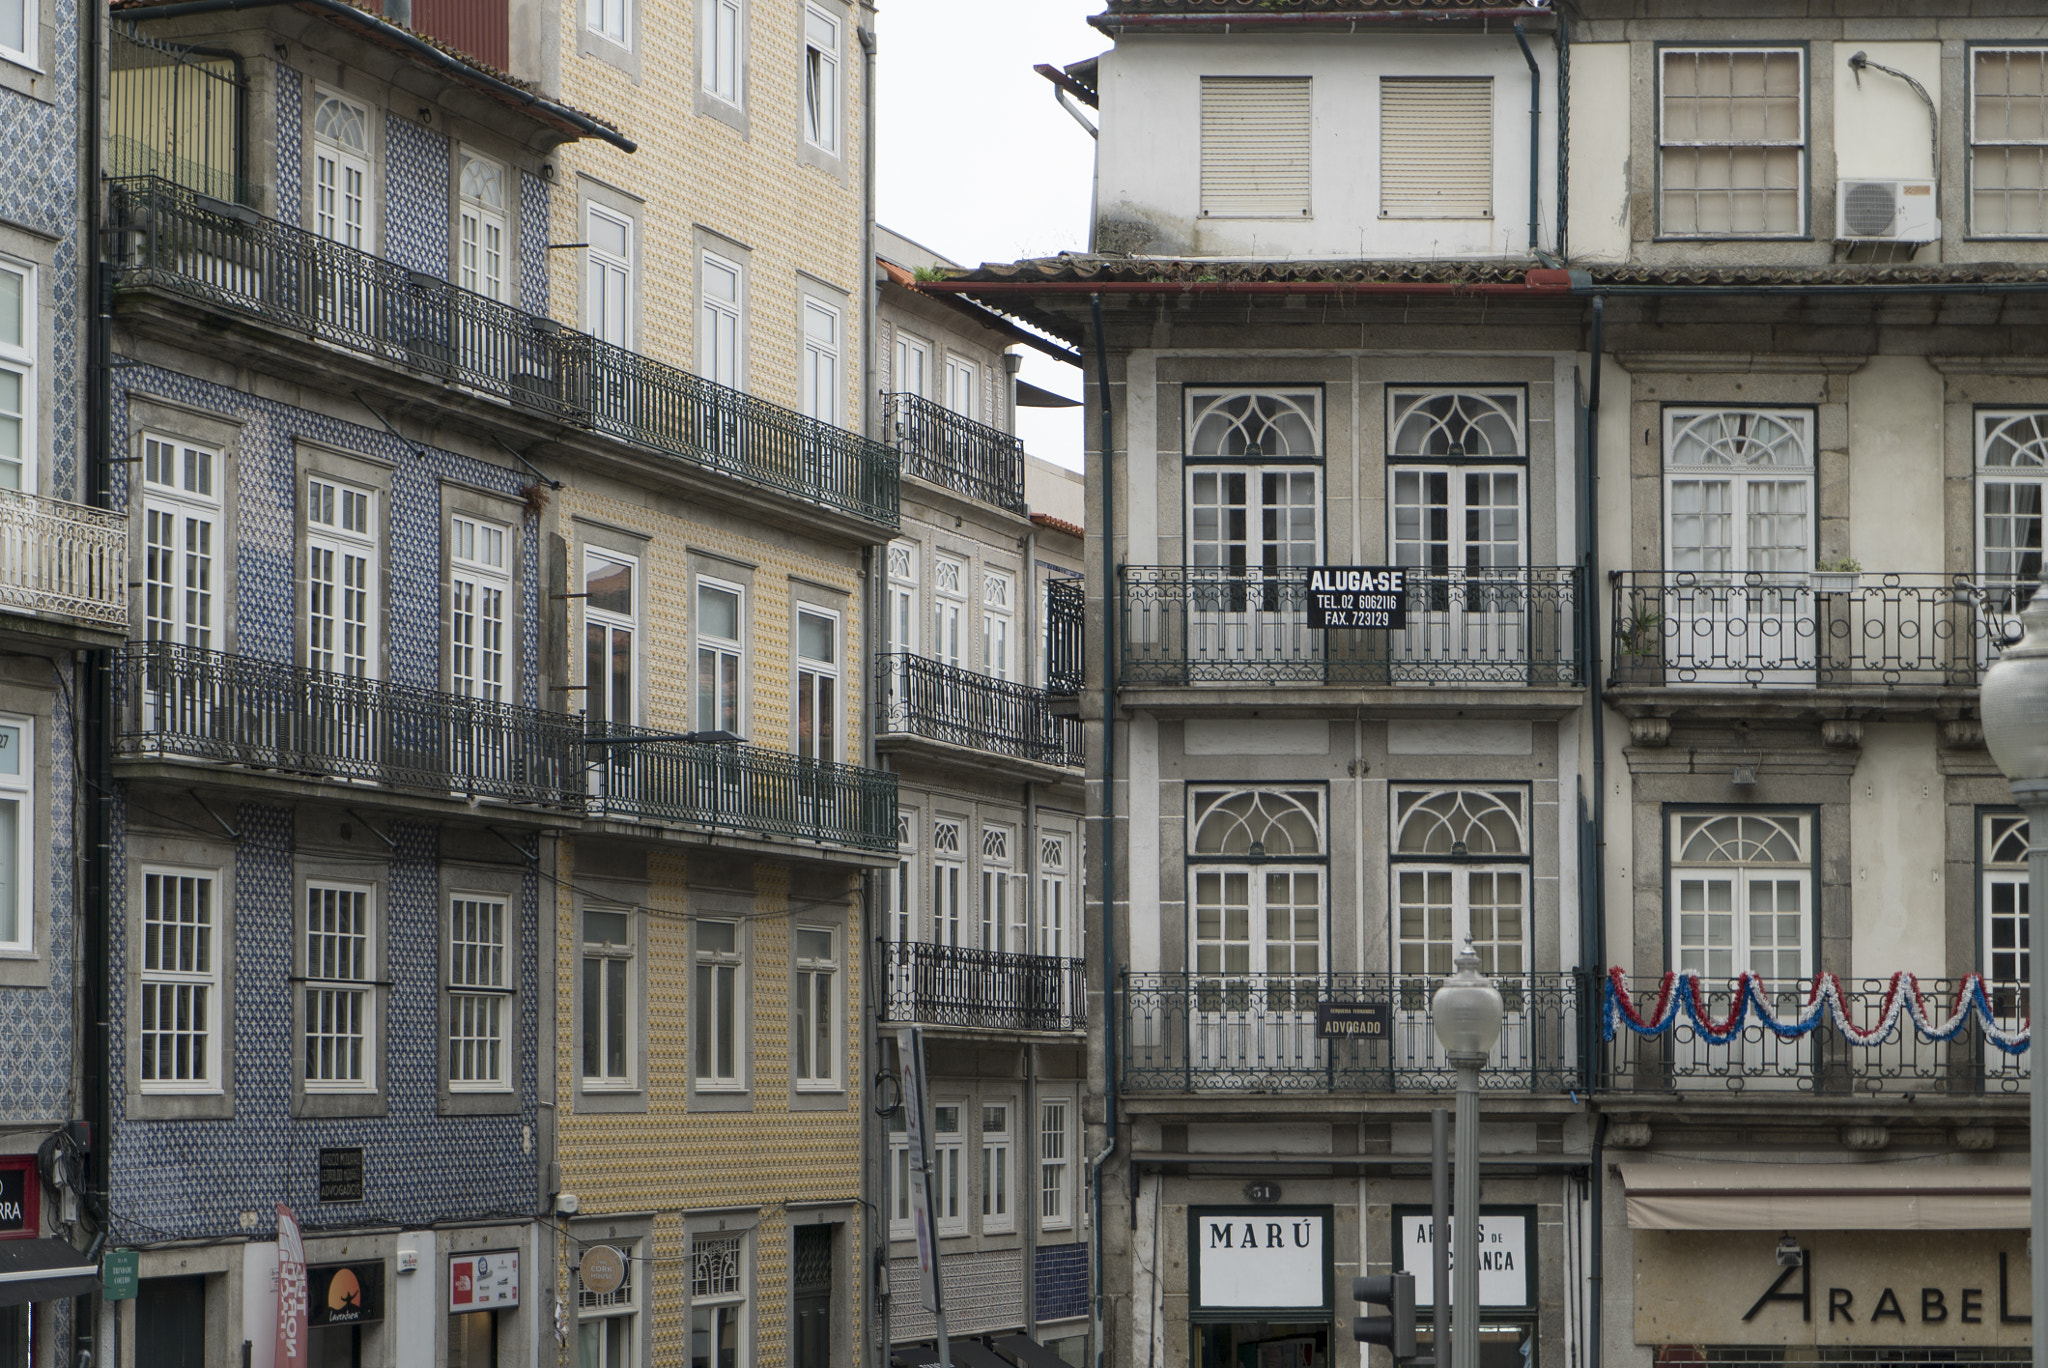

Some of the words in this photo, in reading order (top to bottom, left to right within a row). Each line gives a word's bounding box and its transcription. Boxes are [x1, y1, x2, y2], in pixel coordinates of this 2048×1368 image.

[1310, 570, 1403, 592] ALUGA-SE
[1358, 595, 1397, 610] 6062116
[1324, 611, 1349, 626] FAX.
[1352, 611, 1389, 626] 723129
[1324, 1021, 1381, 1033] ADVOGADO
[1210, 1218, 1311, 1248] MARÚ
[1491, 1233, 1503, 1243] DE
[590, 1265, 613, 1273] CORK
